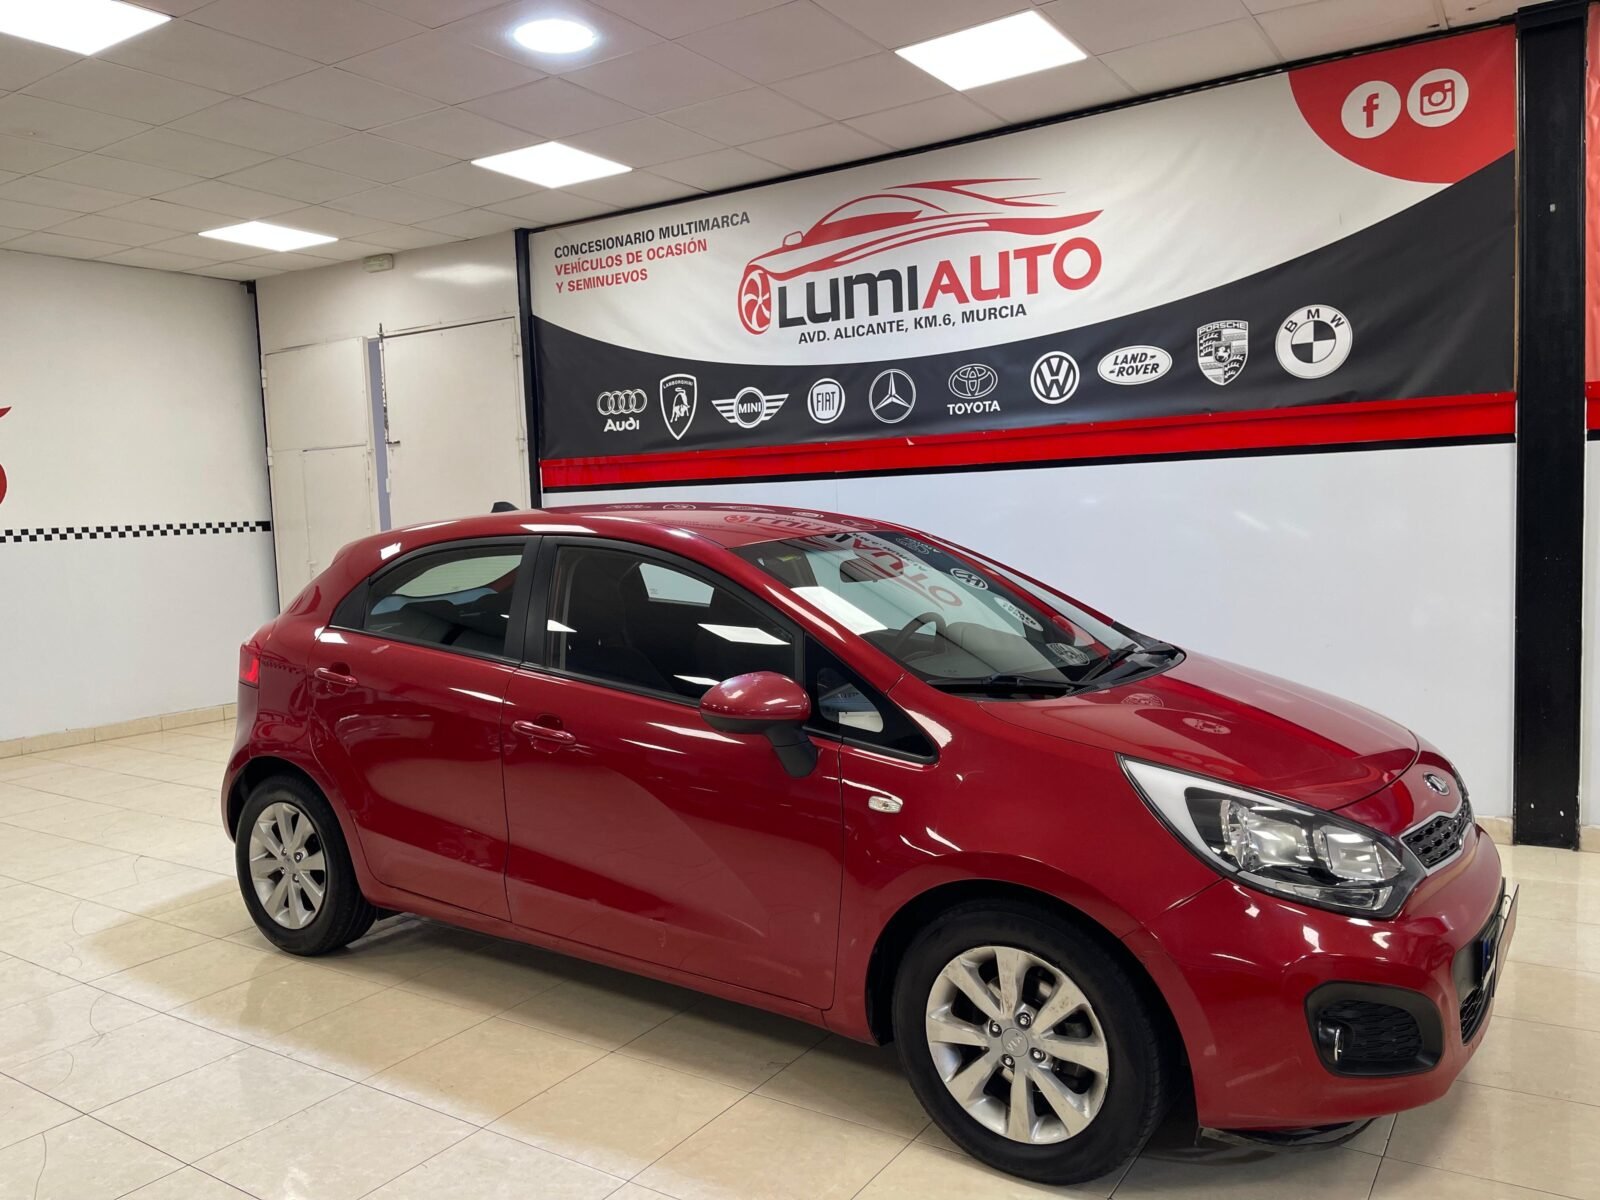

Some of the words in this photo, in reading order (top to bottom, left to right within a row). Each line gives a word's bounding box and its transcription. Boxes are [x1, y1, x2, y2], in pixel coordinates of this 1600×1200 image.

[554, 229, 655, 259] CONCESIONARIO
[658, 211, 750, 239] MULTIMARCA
[555, 253, 623, 276] VEHÍCULOS
[626, 250, 643, 265] DE
[646, 237, 708, 261] OCASIÓN
[555, 281, 564, 294] Y
[567, 268, 648, 292] SEMINUEVOS
[798, 331, 831, 345] AVD.
[833, 319, 909, 341] ALICANTE,
[913, 313, 956, 331] KM.6,
[961, 303, 1028, 324] MURCIA
[1199, 321, 1247, 335] PORSCHE
[738, 402, 763, 414] MINI
[815, 391, 836, 413] FIAT
[947, 400, 1001, 415] TOYOTA
[603, 417, 640, 432] Audi
